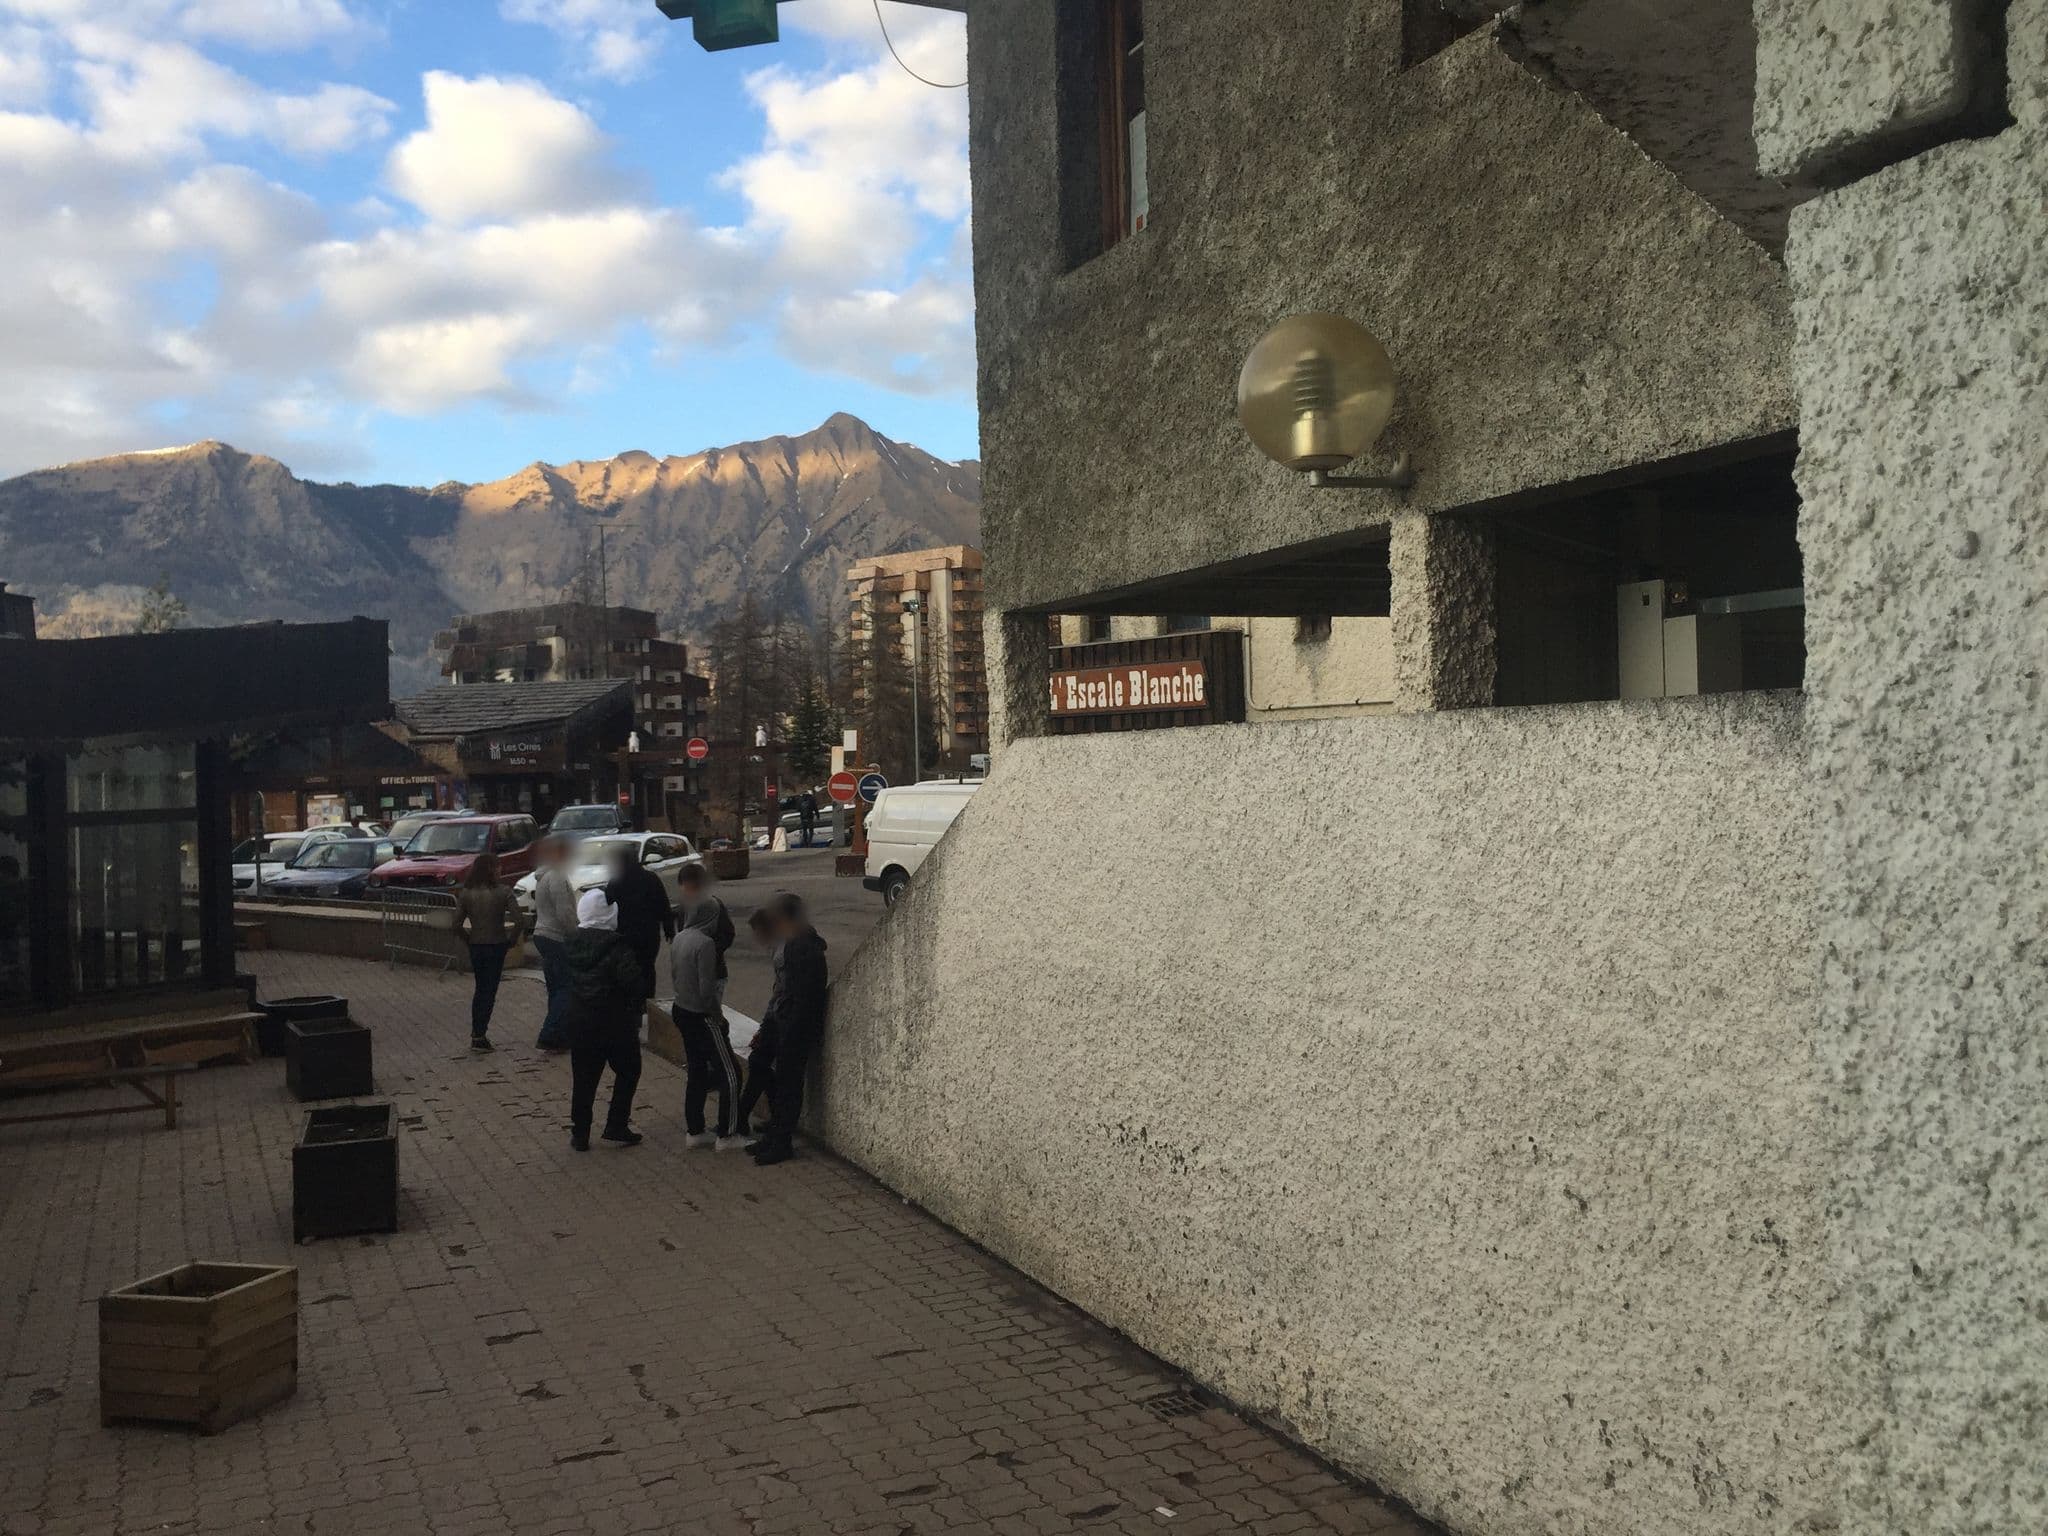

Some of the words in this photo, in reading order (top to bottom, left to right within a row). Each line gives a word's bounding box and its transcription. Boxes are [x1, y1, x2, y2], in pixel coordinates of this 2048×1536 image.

[1049, 672, 1124, 710] L'Escale
[1128, 667, 1204, 706] Blanche
[381, 776, 405, 785] OFFICE
